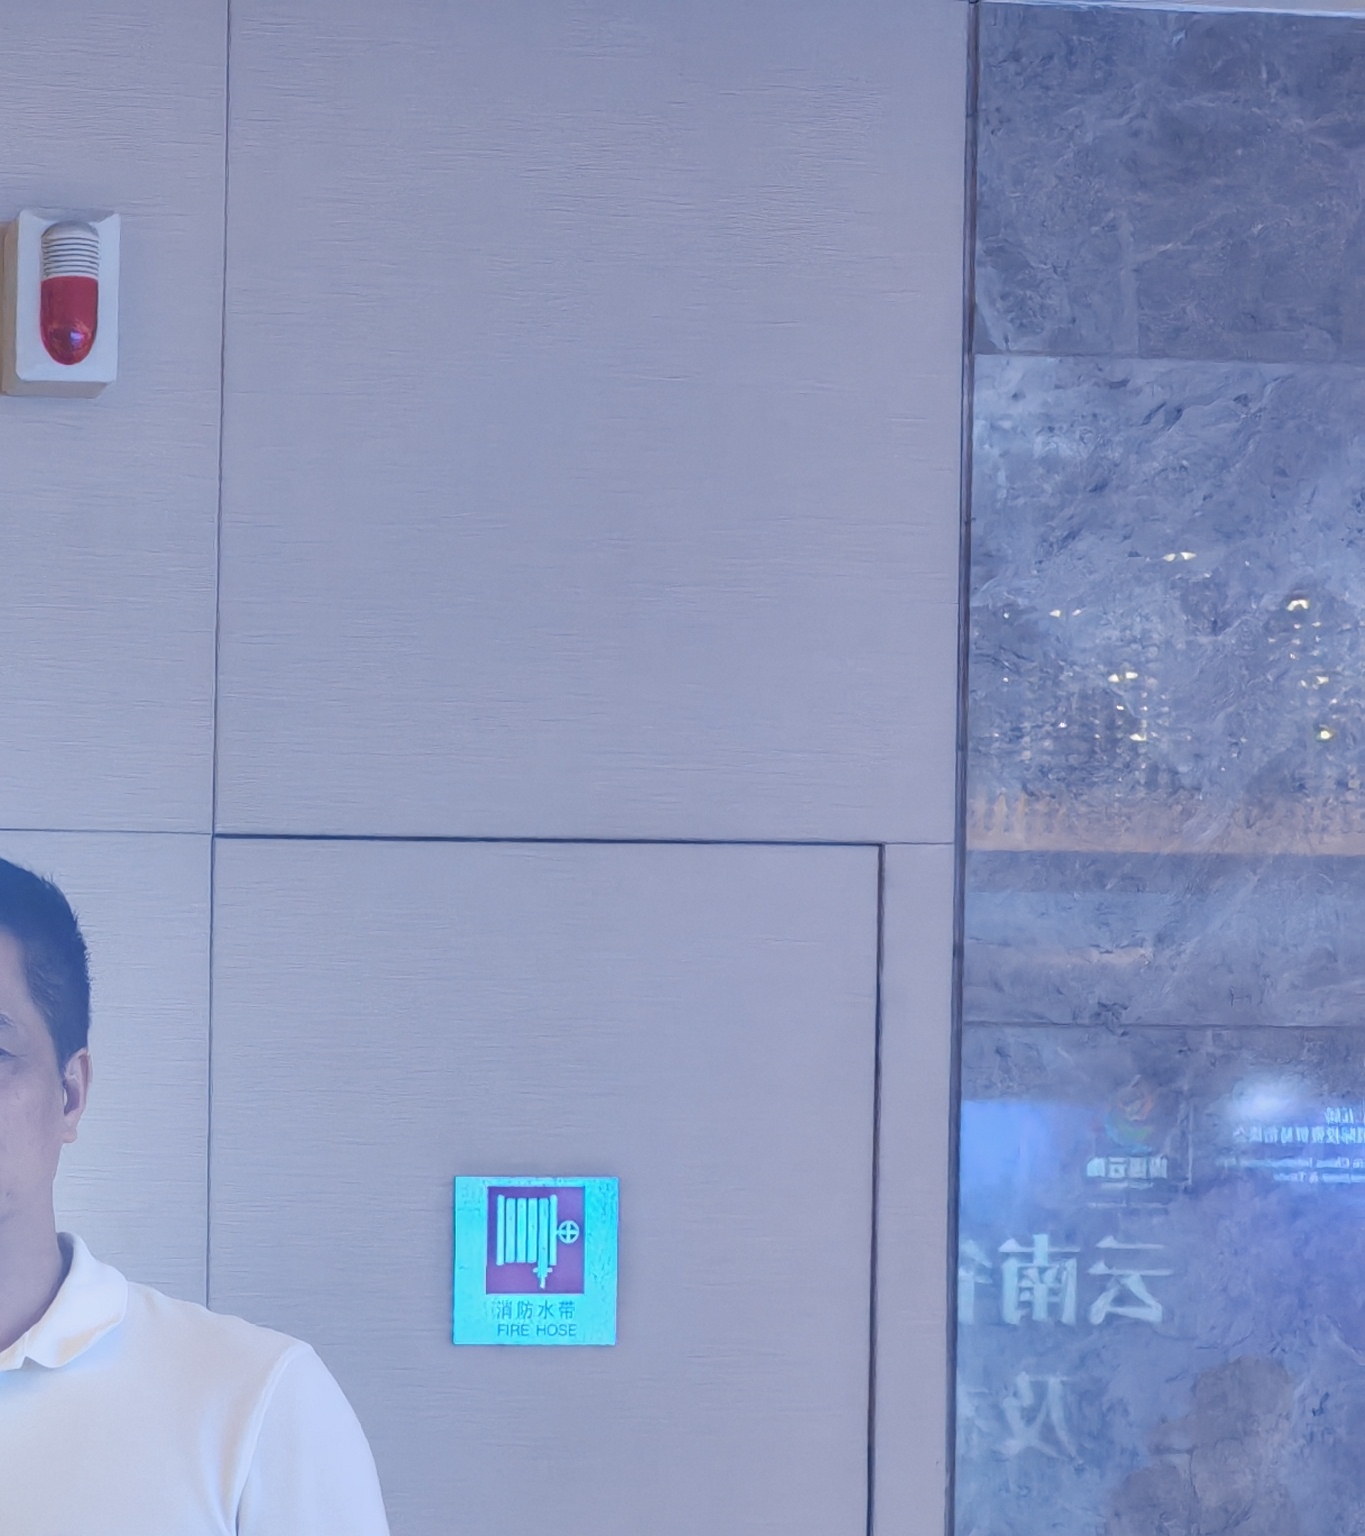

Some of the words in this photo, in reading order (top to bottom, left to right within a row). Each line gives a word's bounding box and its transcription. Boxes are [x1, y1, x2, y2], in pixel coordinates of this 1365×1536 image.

[495, 1300, 576, 1320] 消防水带
[497, 1323, 530, 1337] FIRE
[536, 1323, 577, 1337] HOSE
